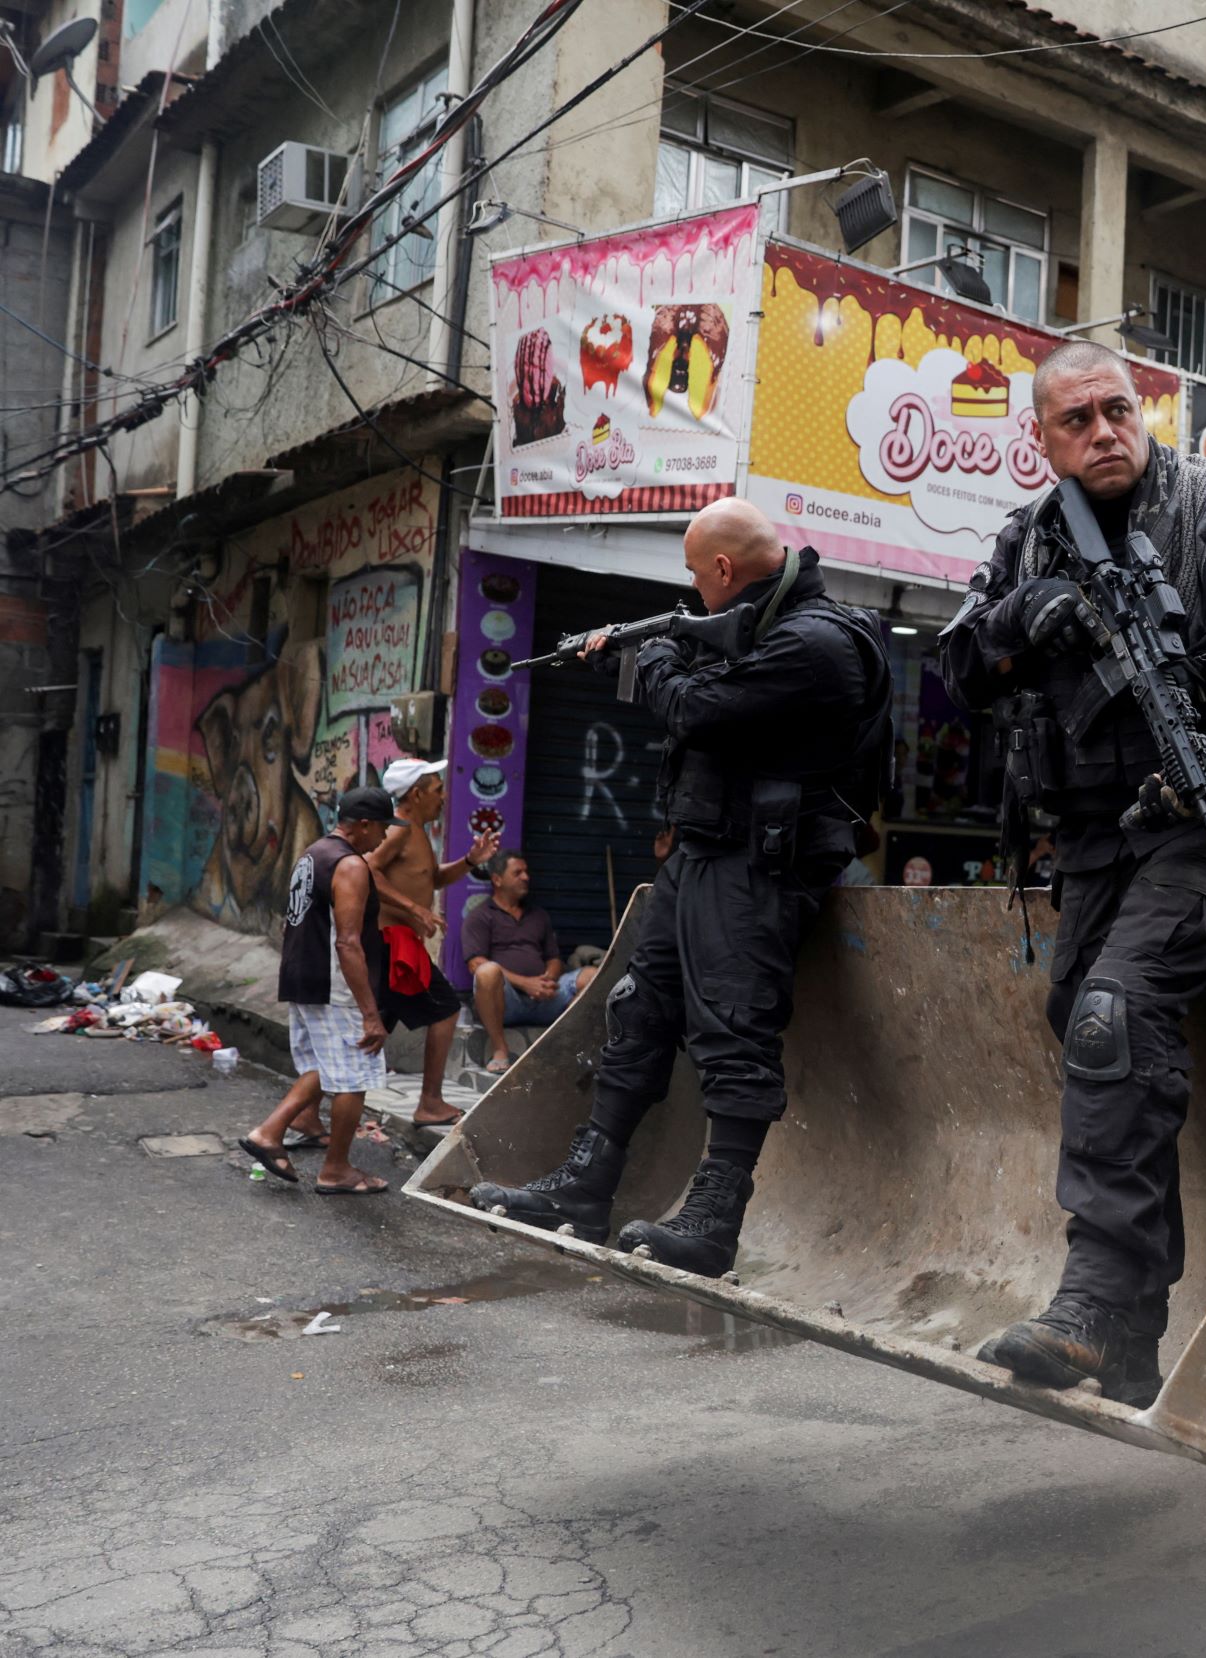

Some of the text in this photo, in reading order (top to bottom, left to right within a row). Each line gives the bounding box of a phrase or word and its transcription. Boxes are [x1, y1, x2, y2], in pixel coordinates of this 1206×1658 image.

[879, 392, 1001, 483] Doce
[575, 428, 635, 483] Doce Bia
[665, 455, 717, 472] 97038-3688
[926, 483, 951, 497] DOCES
[952, 489, 977, 503] FEITOS
[978, 494, 994, 506] COM
[806, 501, 882, 528] docee.abia
